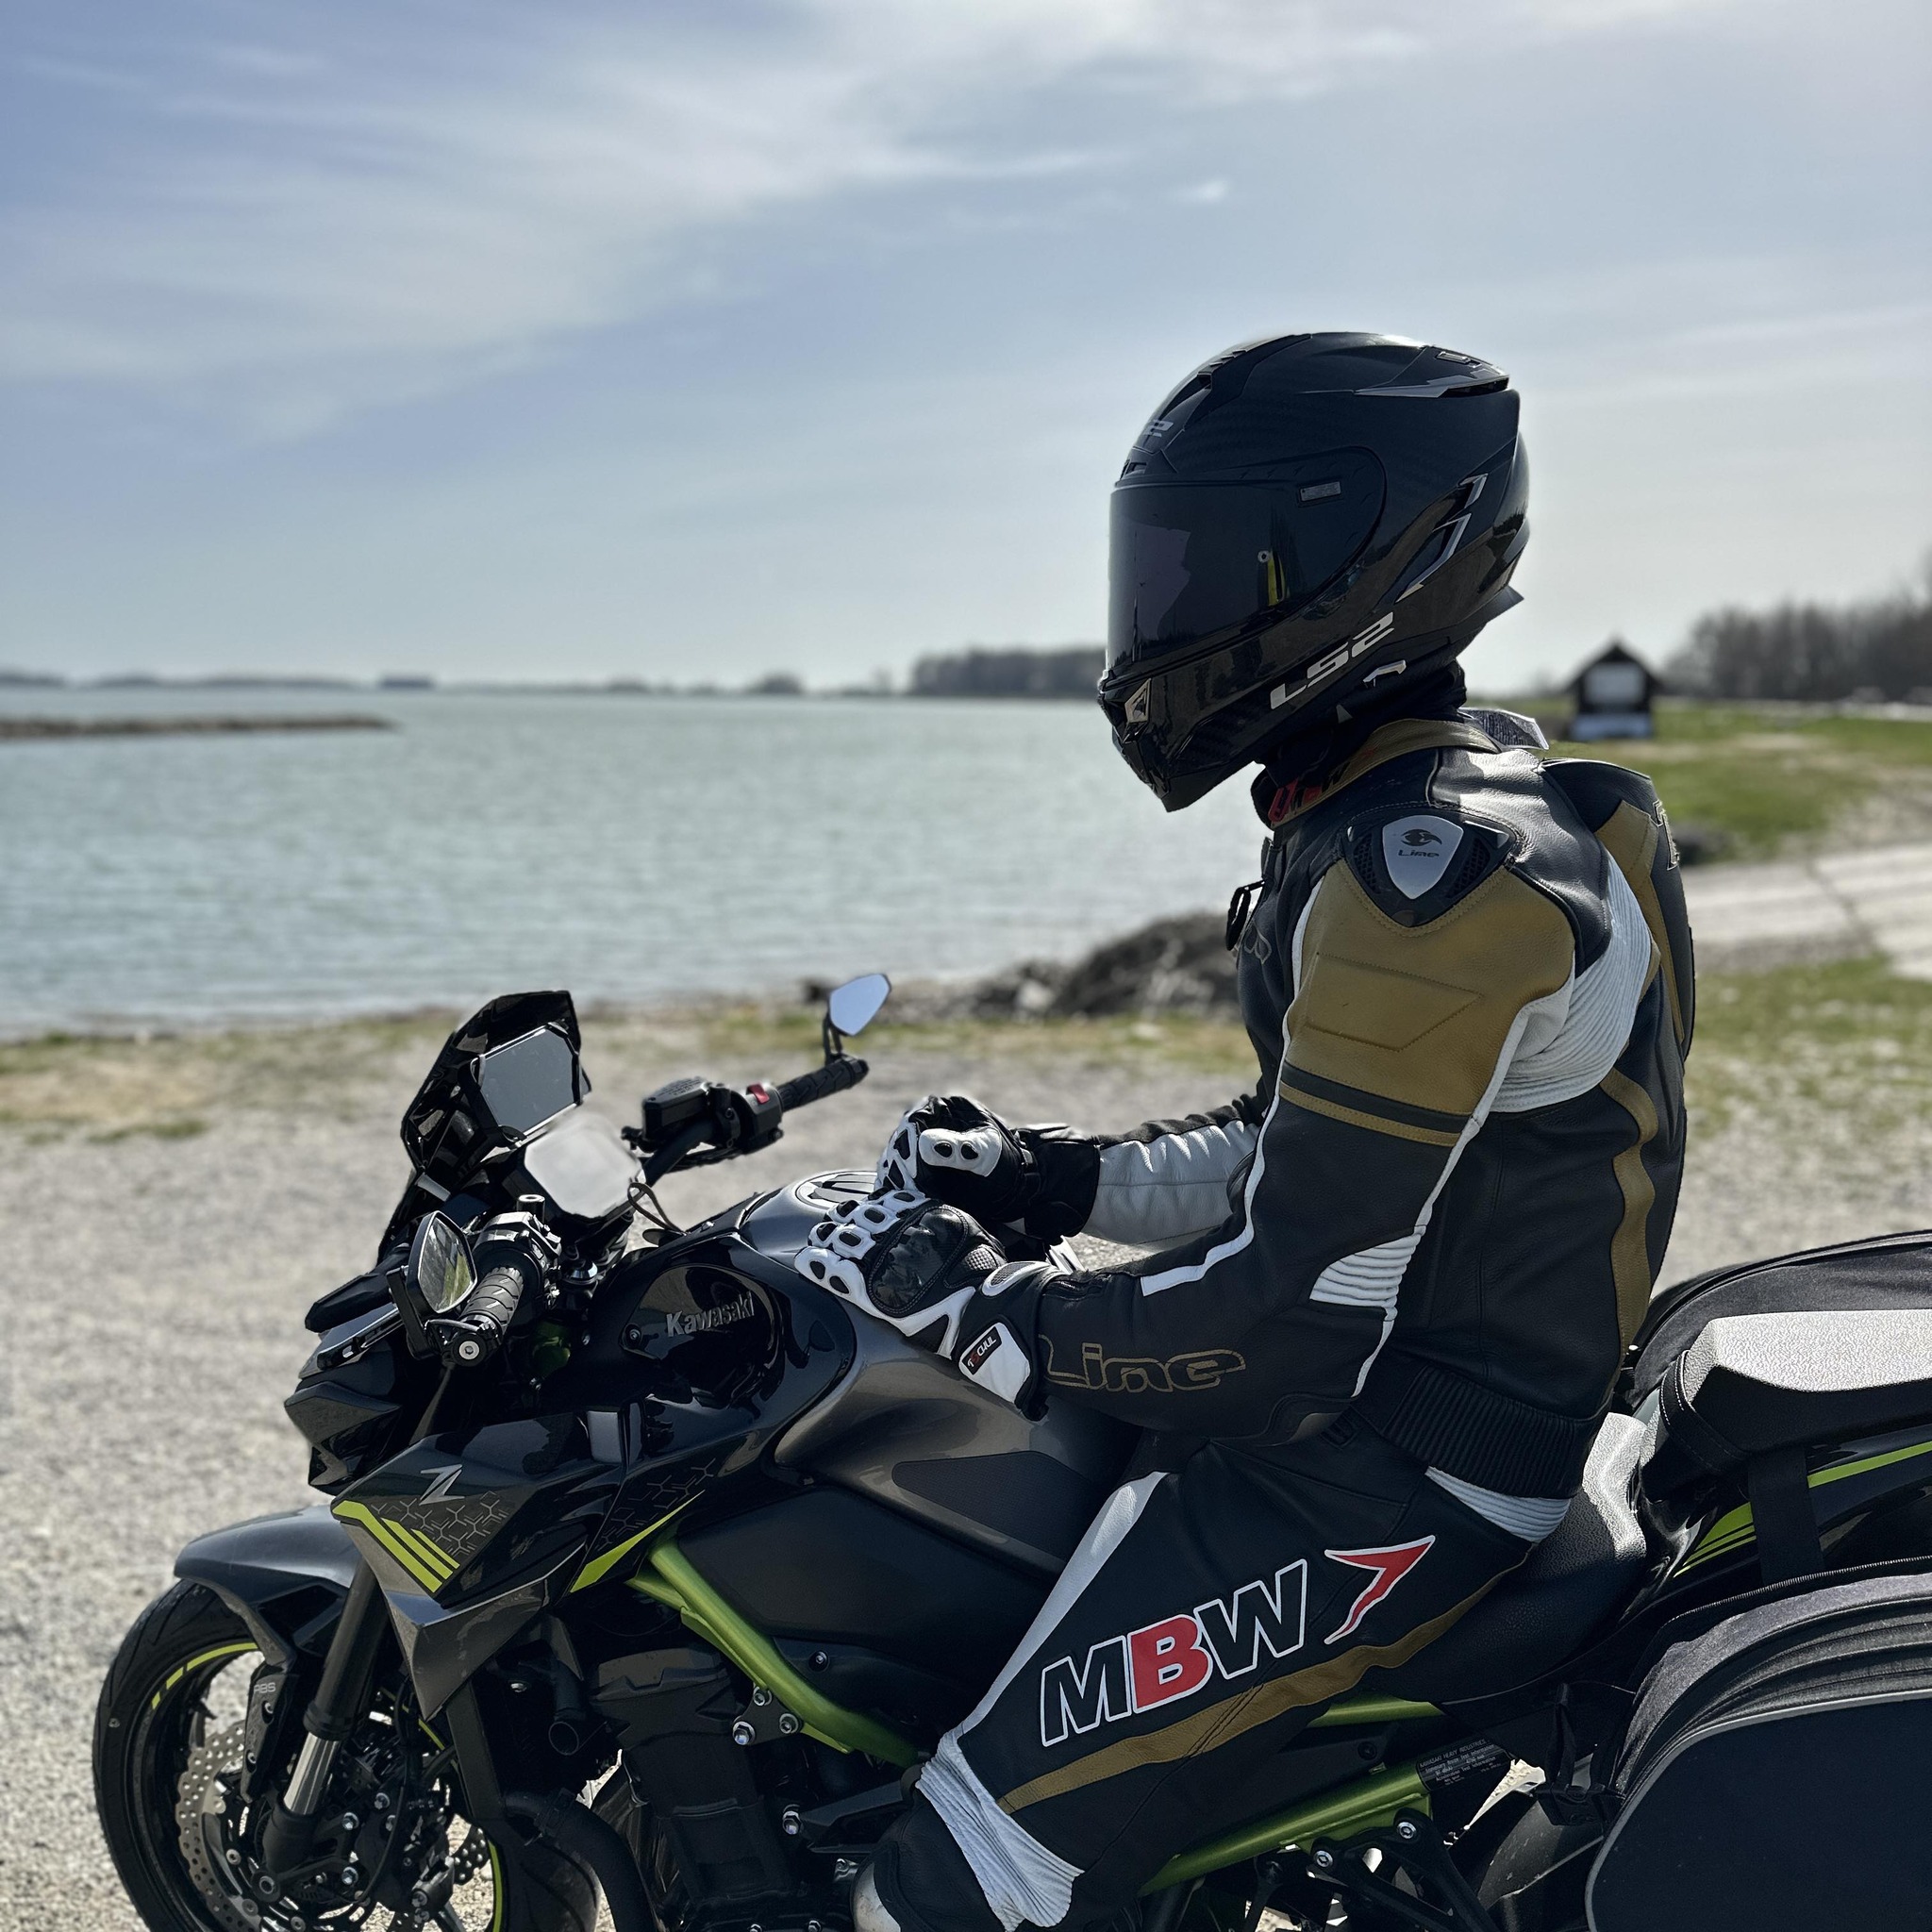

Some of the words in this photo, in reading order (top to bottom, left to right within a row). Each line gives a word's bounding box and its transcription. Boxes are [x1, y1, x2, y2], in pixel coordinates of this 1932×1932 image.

[1270, 611, 1395, 709] LS2
[666, 1291, 755, 1337] Kawasaki
[254, 1682, 275, 1693] ABS
[1040, 1558, 1308, 1747] MBW
